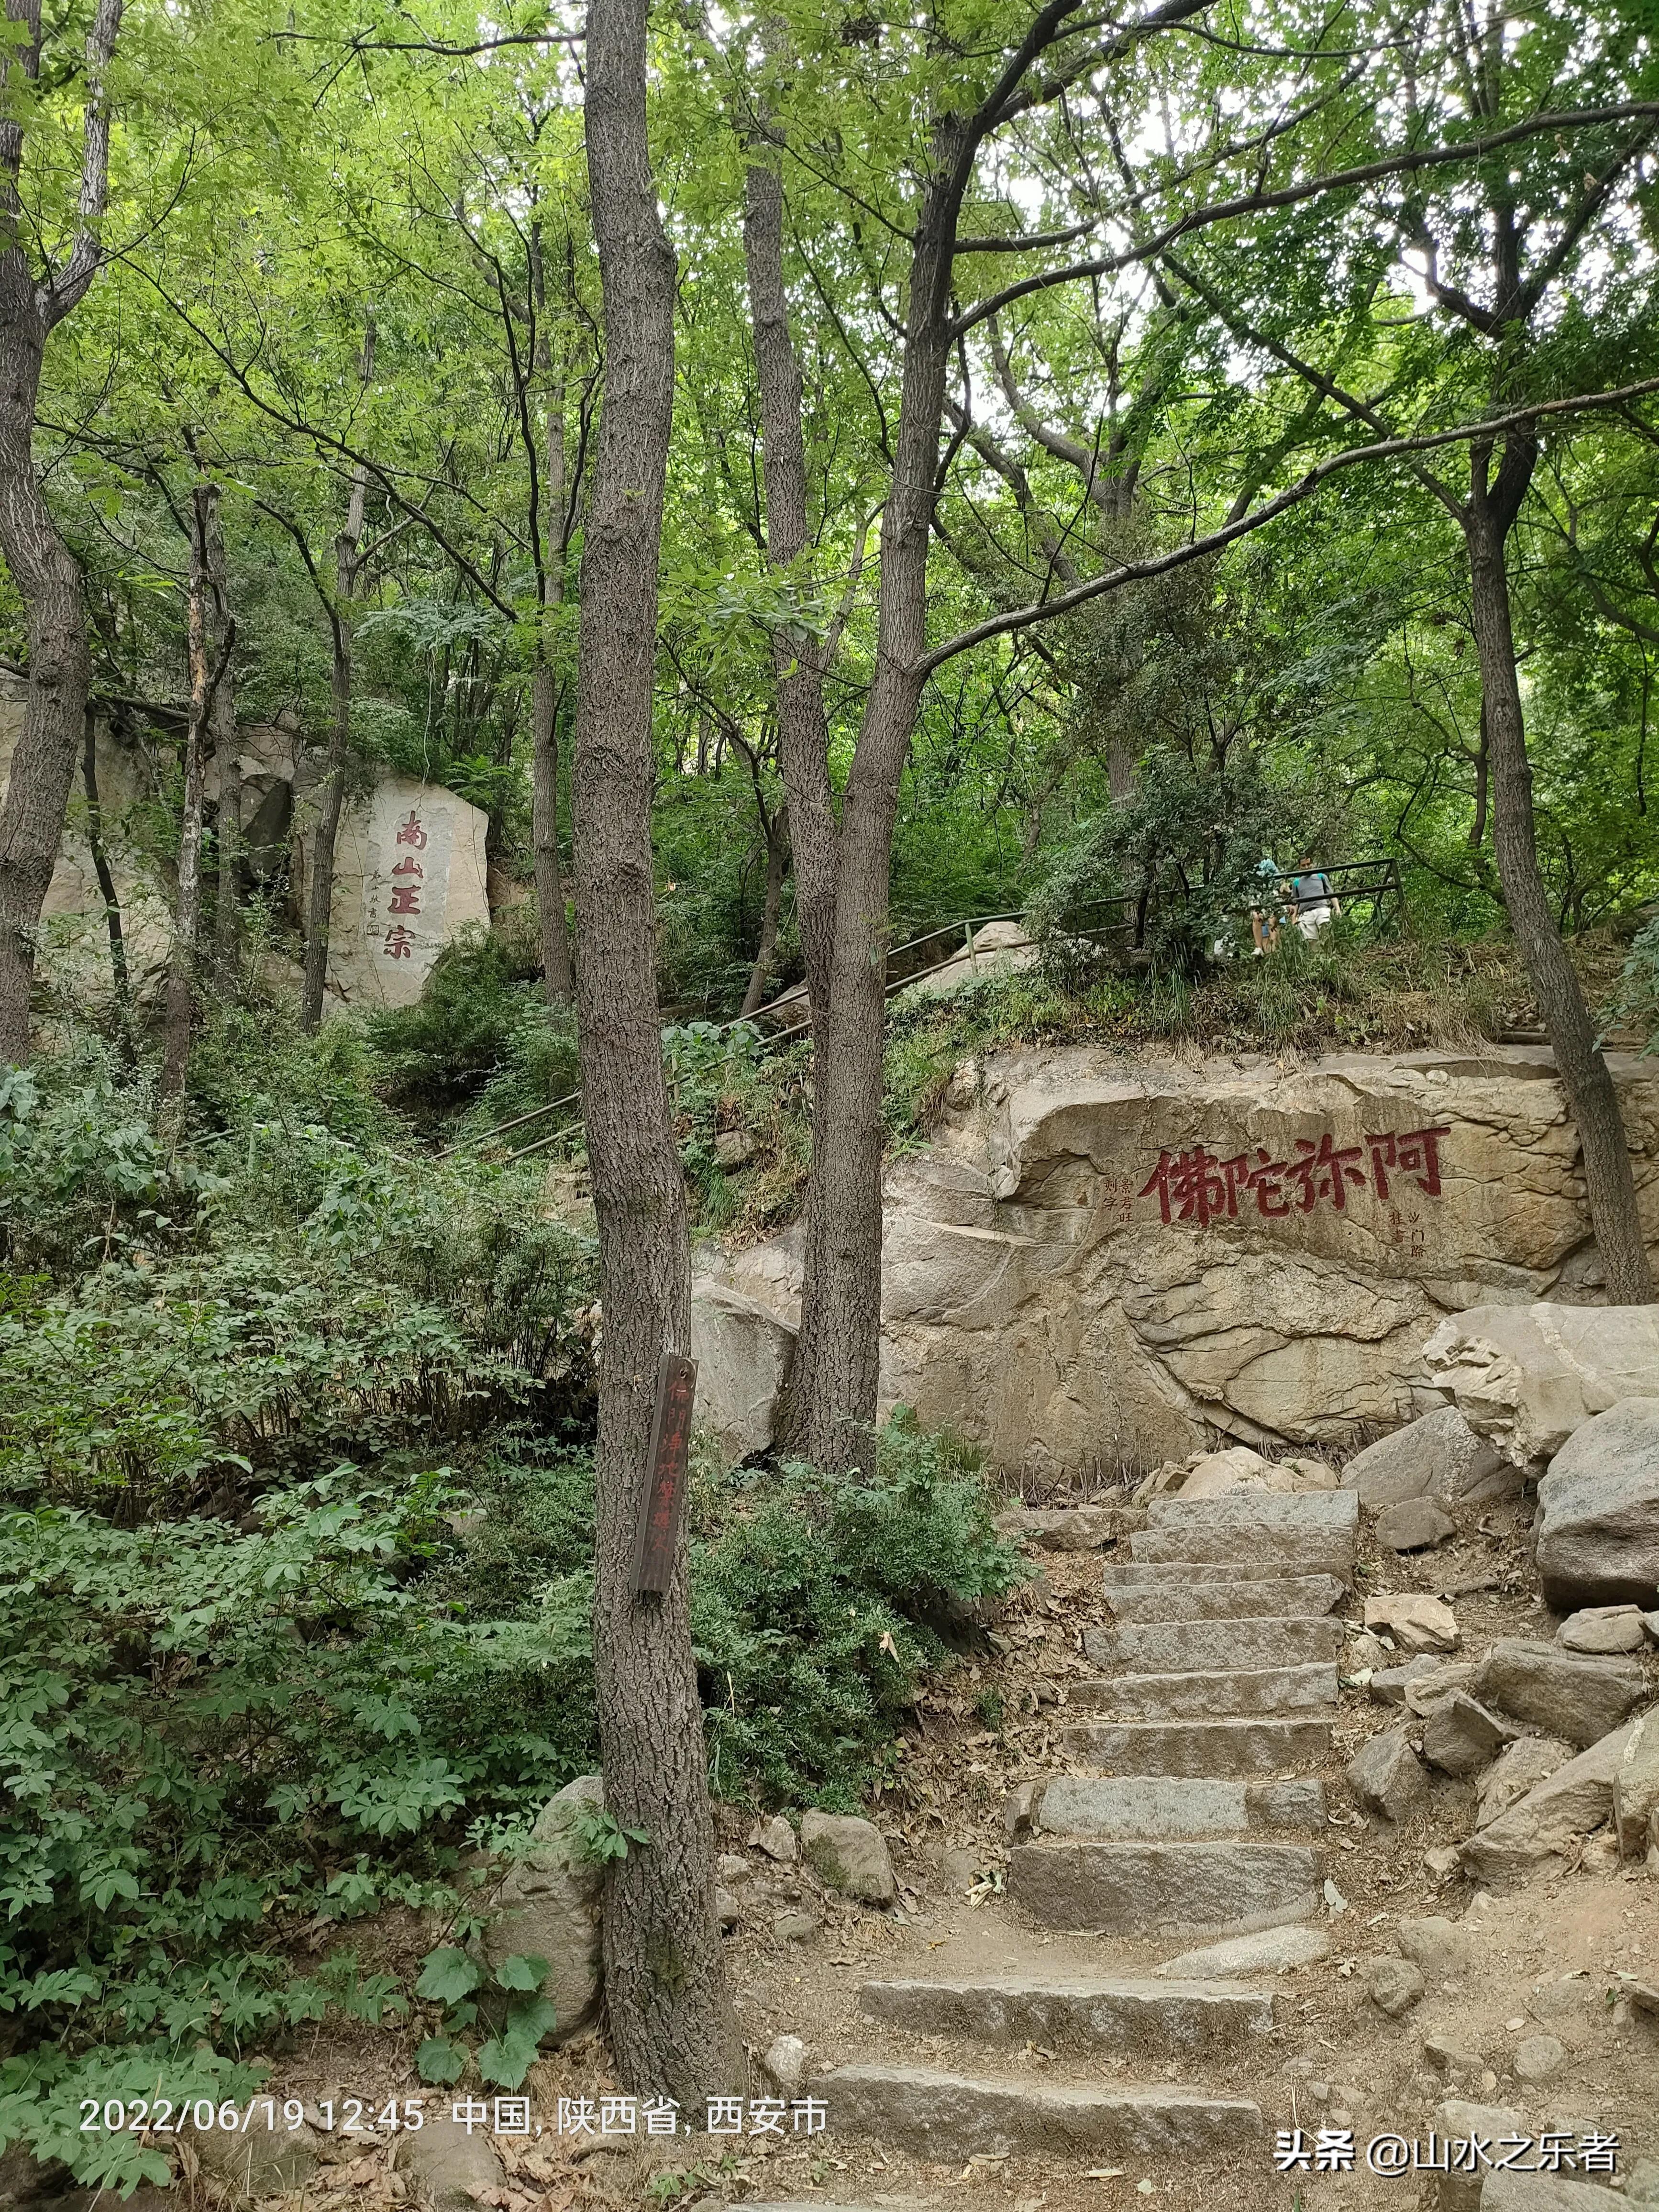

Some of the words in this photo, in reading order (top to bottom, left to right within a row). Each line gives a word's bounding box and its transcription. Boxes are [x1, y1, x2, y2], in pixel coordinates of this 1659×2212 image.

[384, 810, 428, 960] 南山正宗
[1103, 1178, 1118, 1211] 刻字
[1137, 1126, 1451, 1228] 阿弥陀佛
